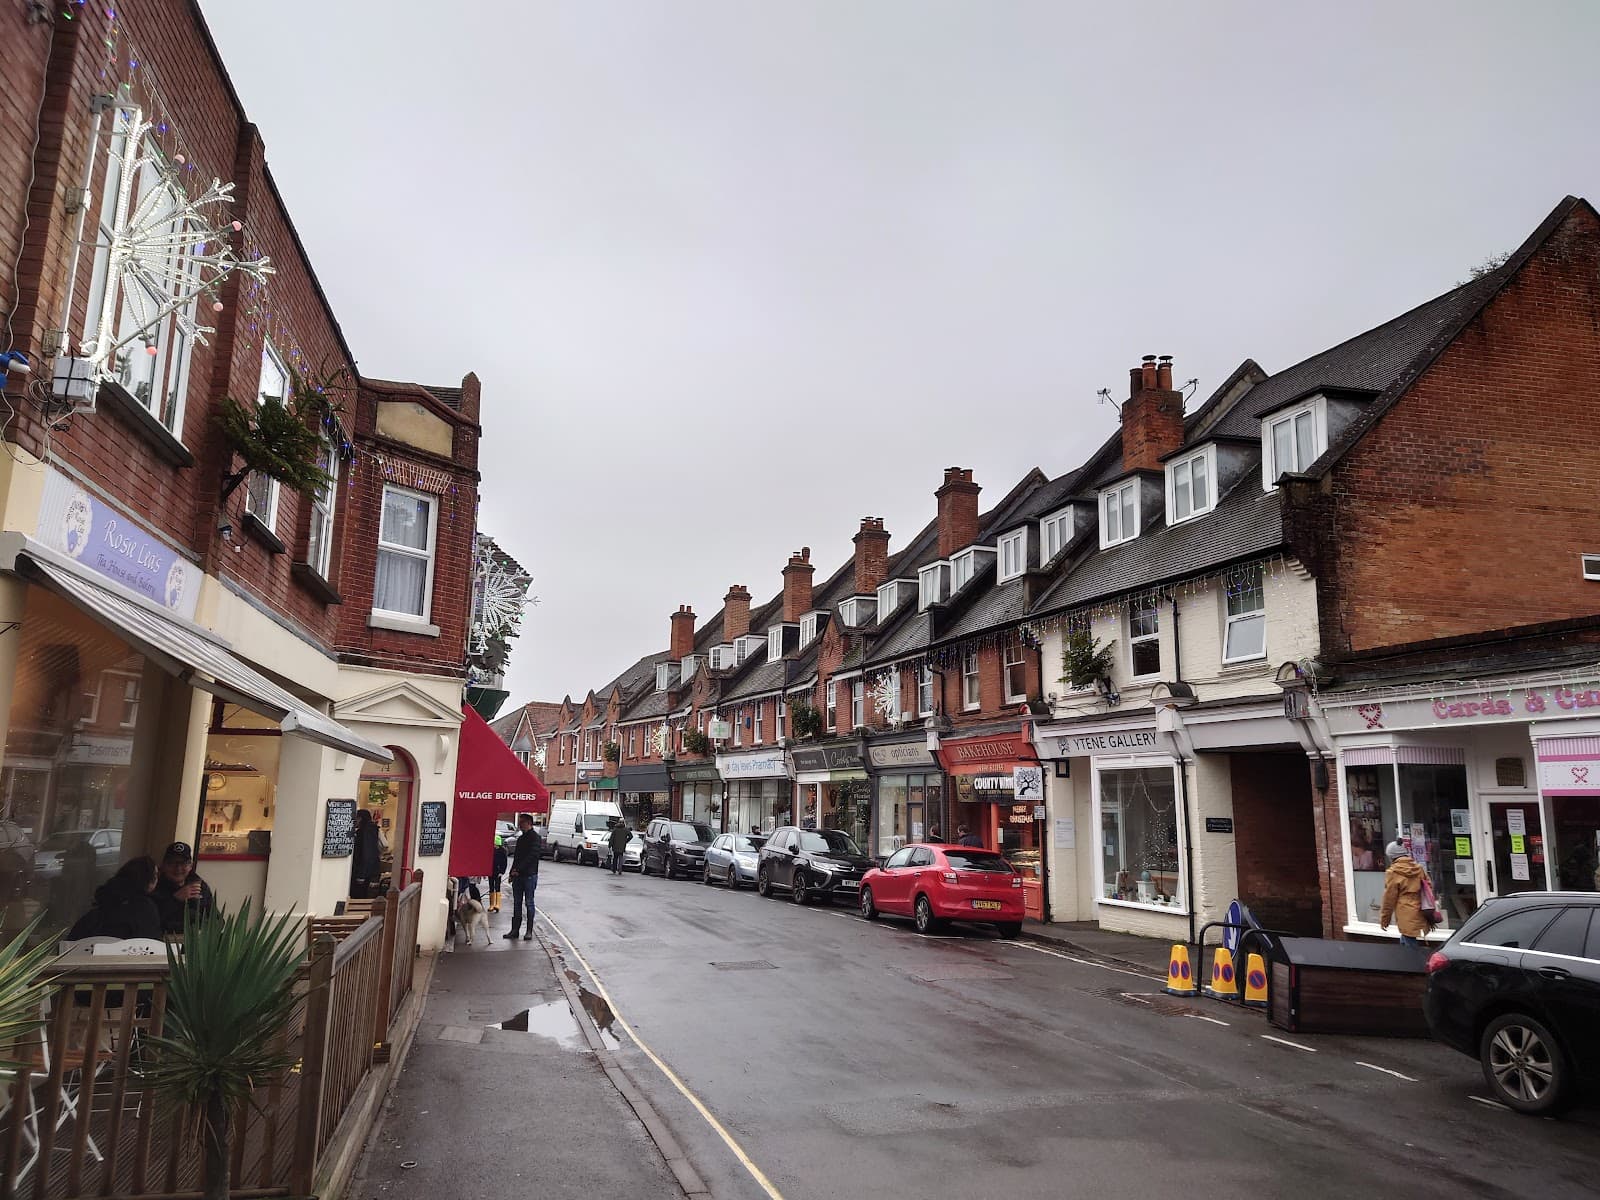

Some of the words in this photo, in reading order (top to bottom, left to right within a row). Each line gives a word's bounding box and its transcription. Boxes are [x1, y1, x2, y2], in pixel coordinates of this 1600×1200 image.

[104, 519, 137, 558] Rosie
[1432, 699, 1511, 719] Cards
[1525, 689, 1546, 713] &
[1073, 735, 1106, 751] YTENE
[1109, 732, 1156, 749] GALLERY
[891, 746, 920, 760] opticians
[957, 743, 1014, 758] BAKEHOUSE
[974, 777, 999, 790] COUNTY
[495, 792, 536, 800] BUTCHERS
